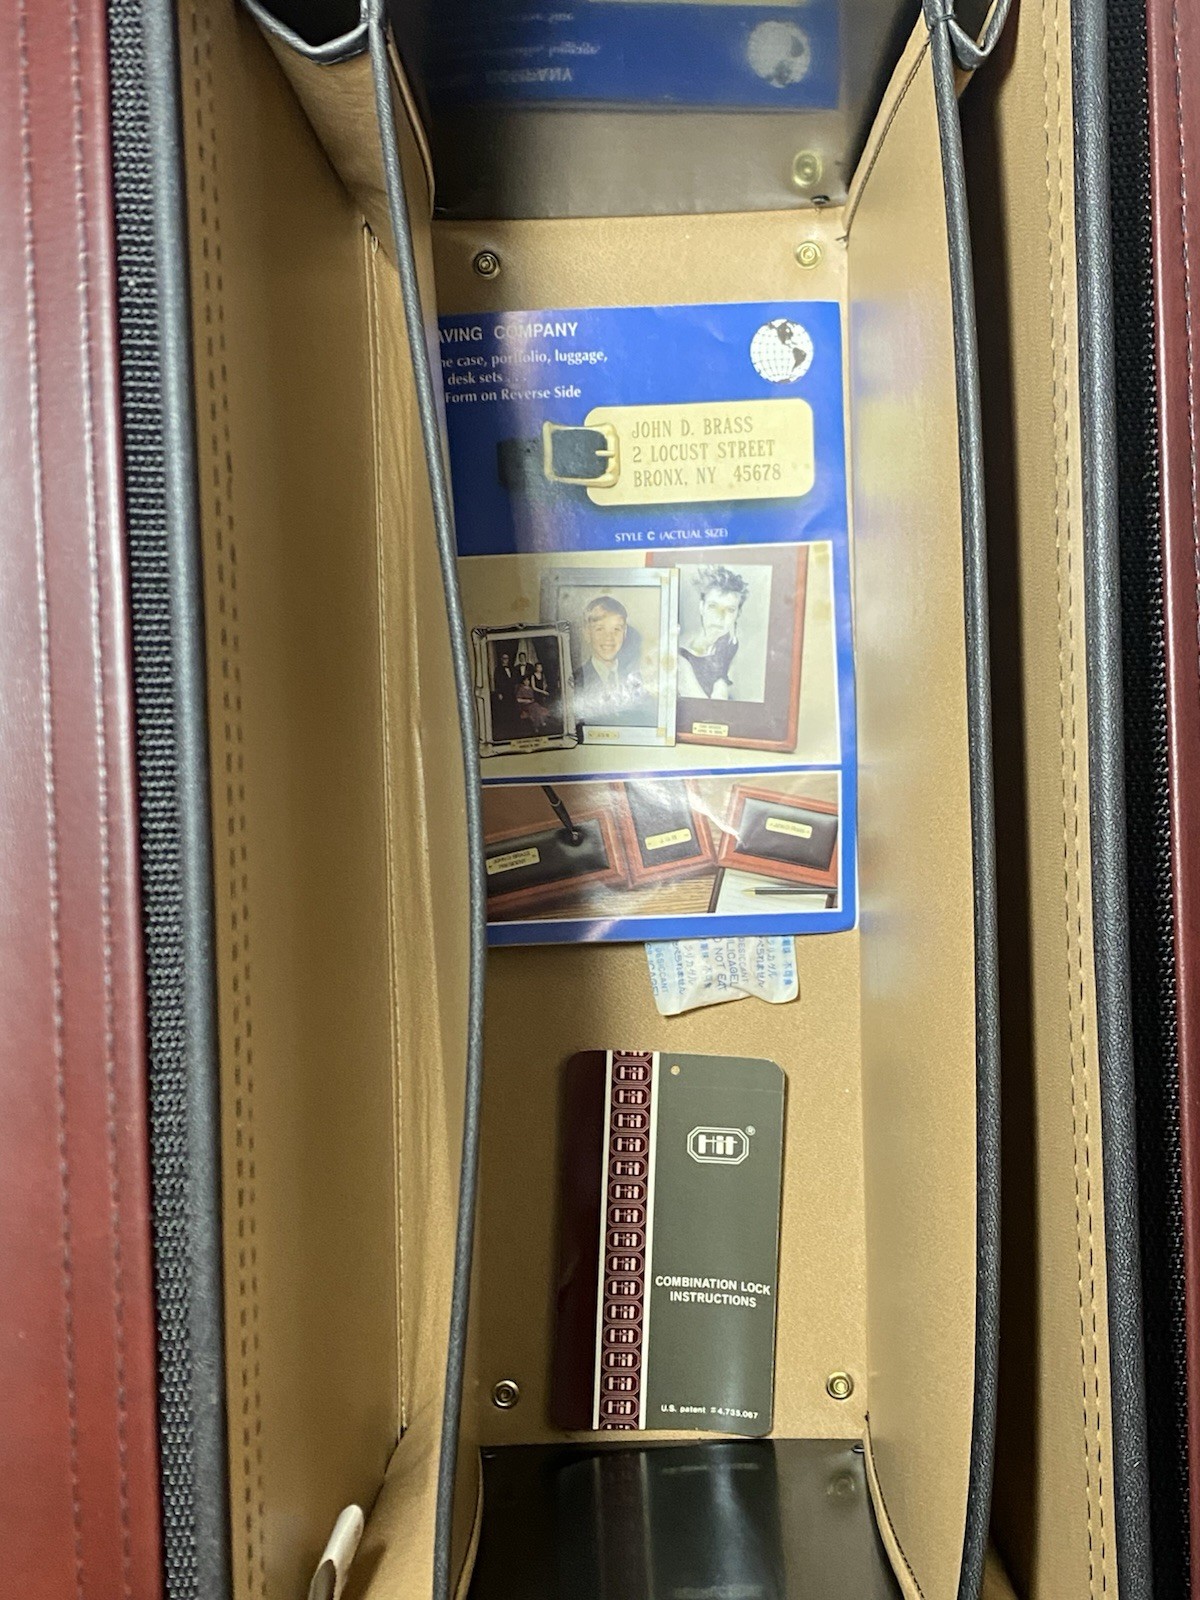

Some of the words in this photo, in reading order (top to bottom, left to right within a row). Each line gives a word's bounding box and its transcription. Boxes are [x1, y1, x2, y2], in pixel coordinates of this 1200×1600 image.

[494, 322, 578, 340] COMPANY
[457, 355, 488, 368] case,
[492, 350, 551, 368] portfolio,
[554, 349, 608, 366] luggage,
[448, 371, 476, 386] desk
[479, 371, 503, 383] sets
[445, 391, 477, 404] Form
[481, 390, 497, 402] on
[501, 388, 551, 400] Reverse
[554, 384, 582, 398] Side
[632, 420, 672, 438] JOHN
[681, 420, 694, 436] D.
[703, 416, 754, 435] BRASS
[632, 446, 642, 462] 2
[651, 443, 708, 462] LOCUST
[717, 439, 775, 458] STREET
[696, 467, 716, 484] NY
[734, 464, 782, 482] 45678
[615, 532, 643, 542] STYLE
[647, 531, 656, 540] C
[660, 530, 700, 540] (ACTUAL
[704, 528, 728, 538] SIZE)
[714, 947, 726, 968] NOT
[726, 939, 740, 987] ILICAGEL
[716, 973, 728, 992] EAT
[655, 1276, 738, 1290] COMBINATION
[741, 1281, 771, 1296] LOCK
[670, 1291, 756, 1308] INSTRUCTIONS
[660, 1404, 676, 1412] U.S.
[680, 1404, 706, 1414] patent
